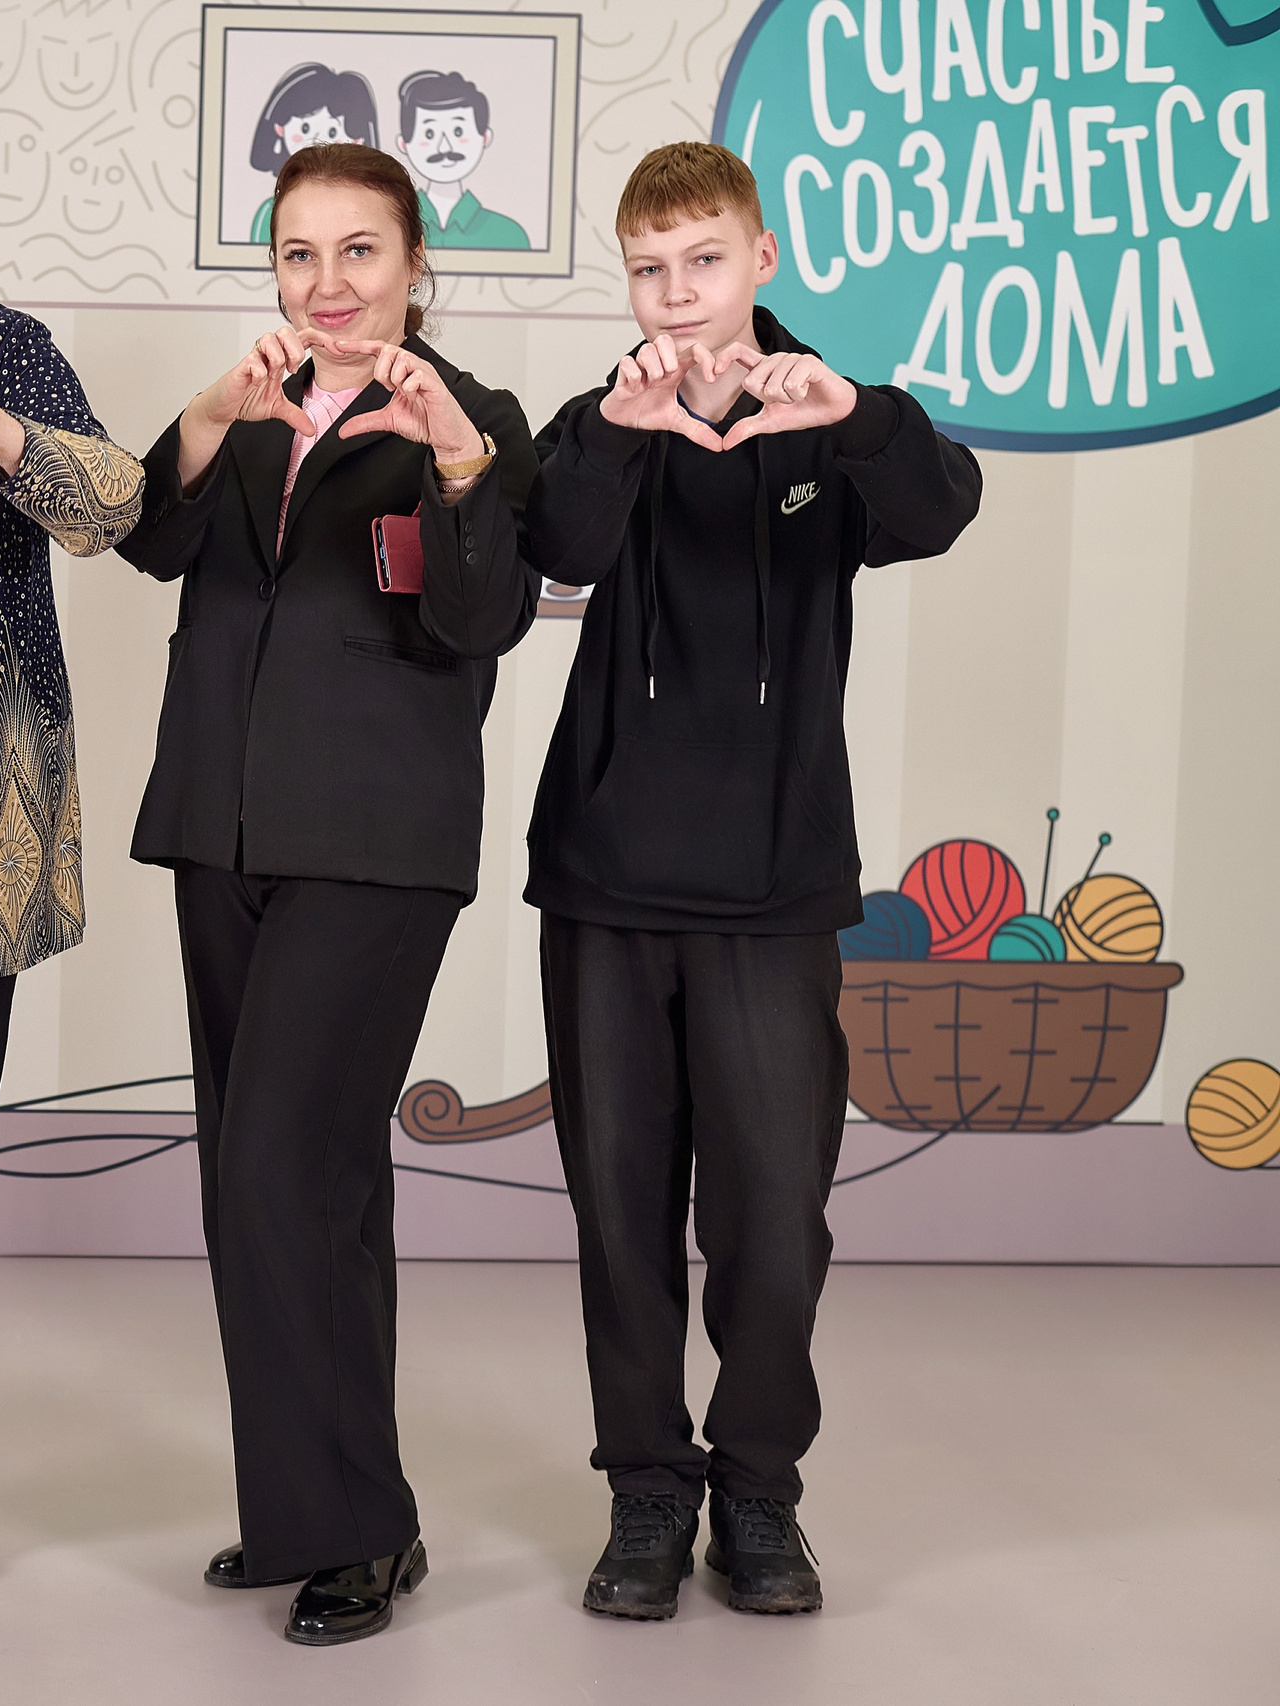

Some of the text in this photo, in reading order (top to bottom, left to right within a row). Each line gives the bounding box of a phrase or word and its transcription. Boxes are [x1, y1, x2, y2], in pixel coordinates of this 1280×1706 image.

[783, 85, 1269, 294] СОЗДАЕТСЯ
[891, 237, 1215, 409] ДОМА
[788, 481, 816, 504] NIKE
